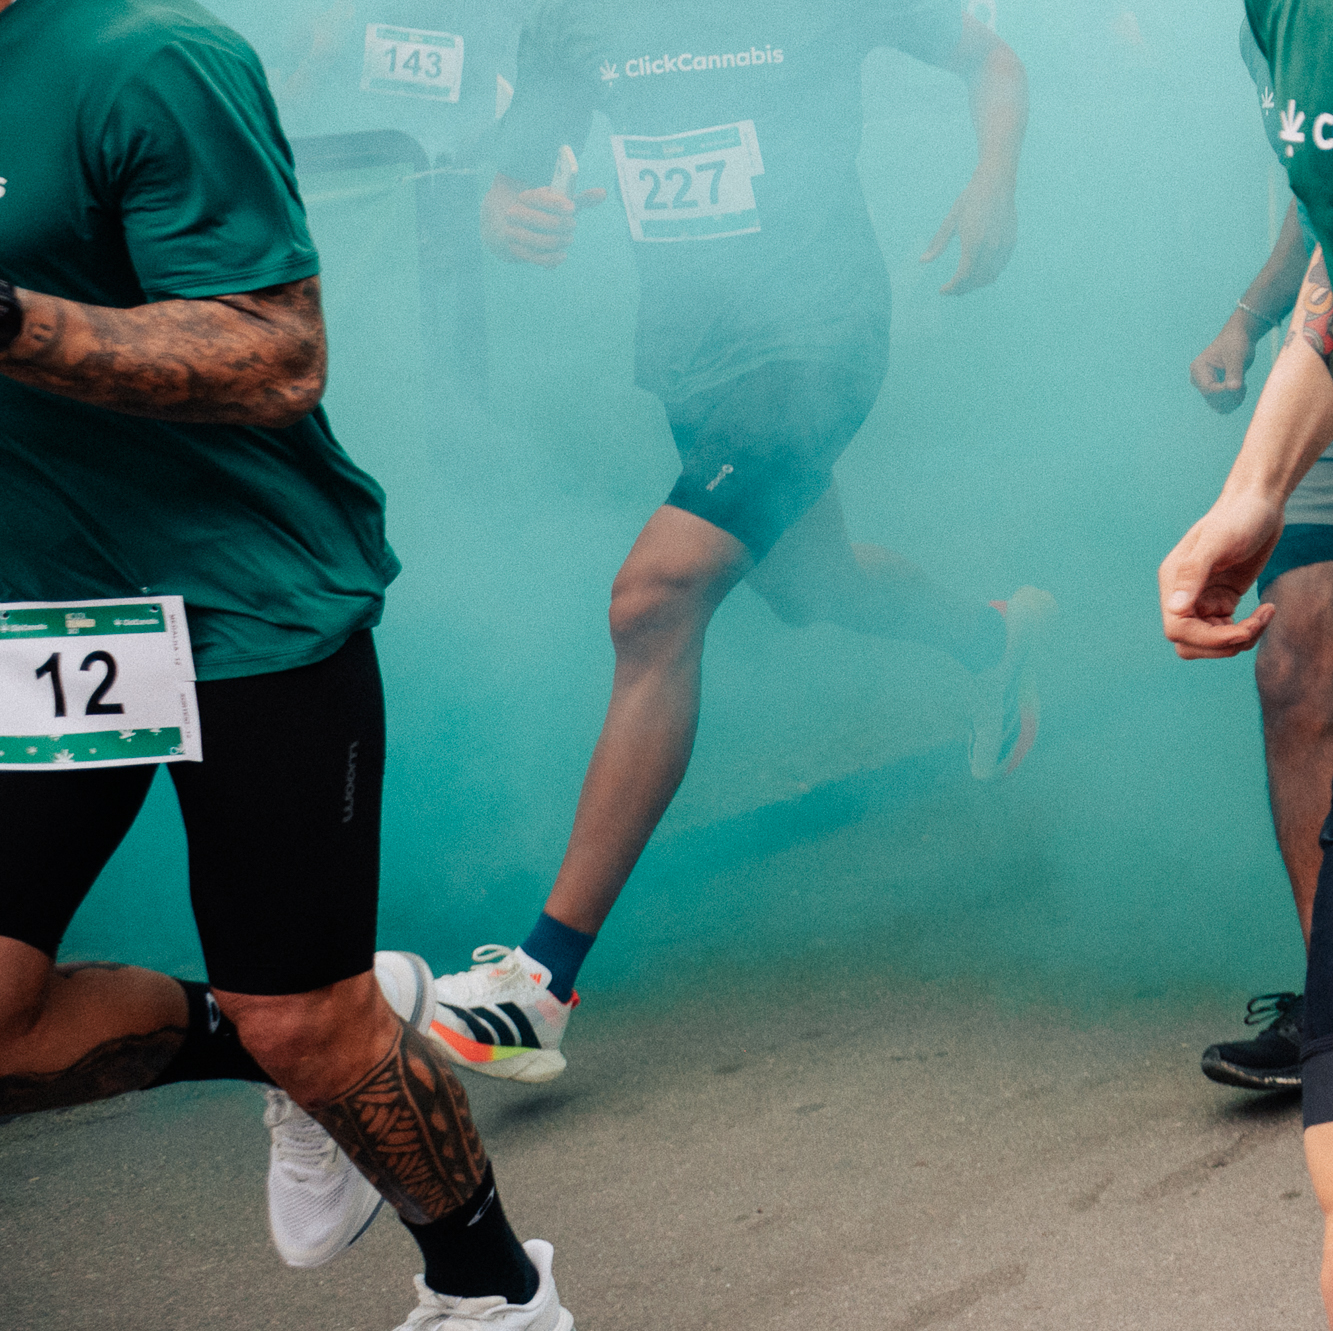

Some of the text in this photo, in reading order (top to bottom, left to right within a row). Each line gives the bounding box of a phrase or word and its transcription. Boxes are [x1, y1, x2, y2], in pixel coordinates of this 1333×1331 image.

[385, 46, 442, 79] 143
[624, 44, 784, 78] ClickCannabis
[638, 160, 728, 212] 227
[35, 650, 125, 717] 12
